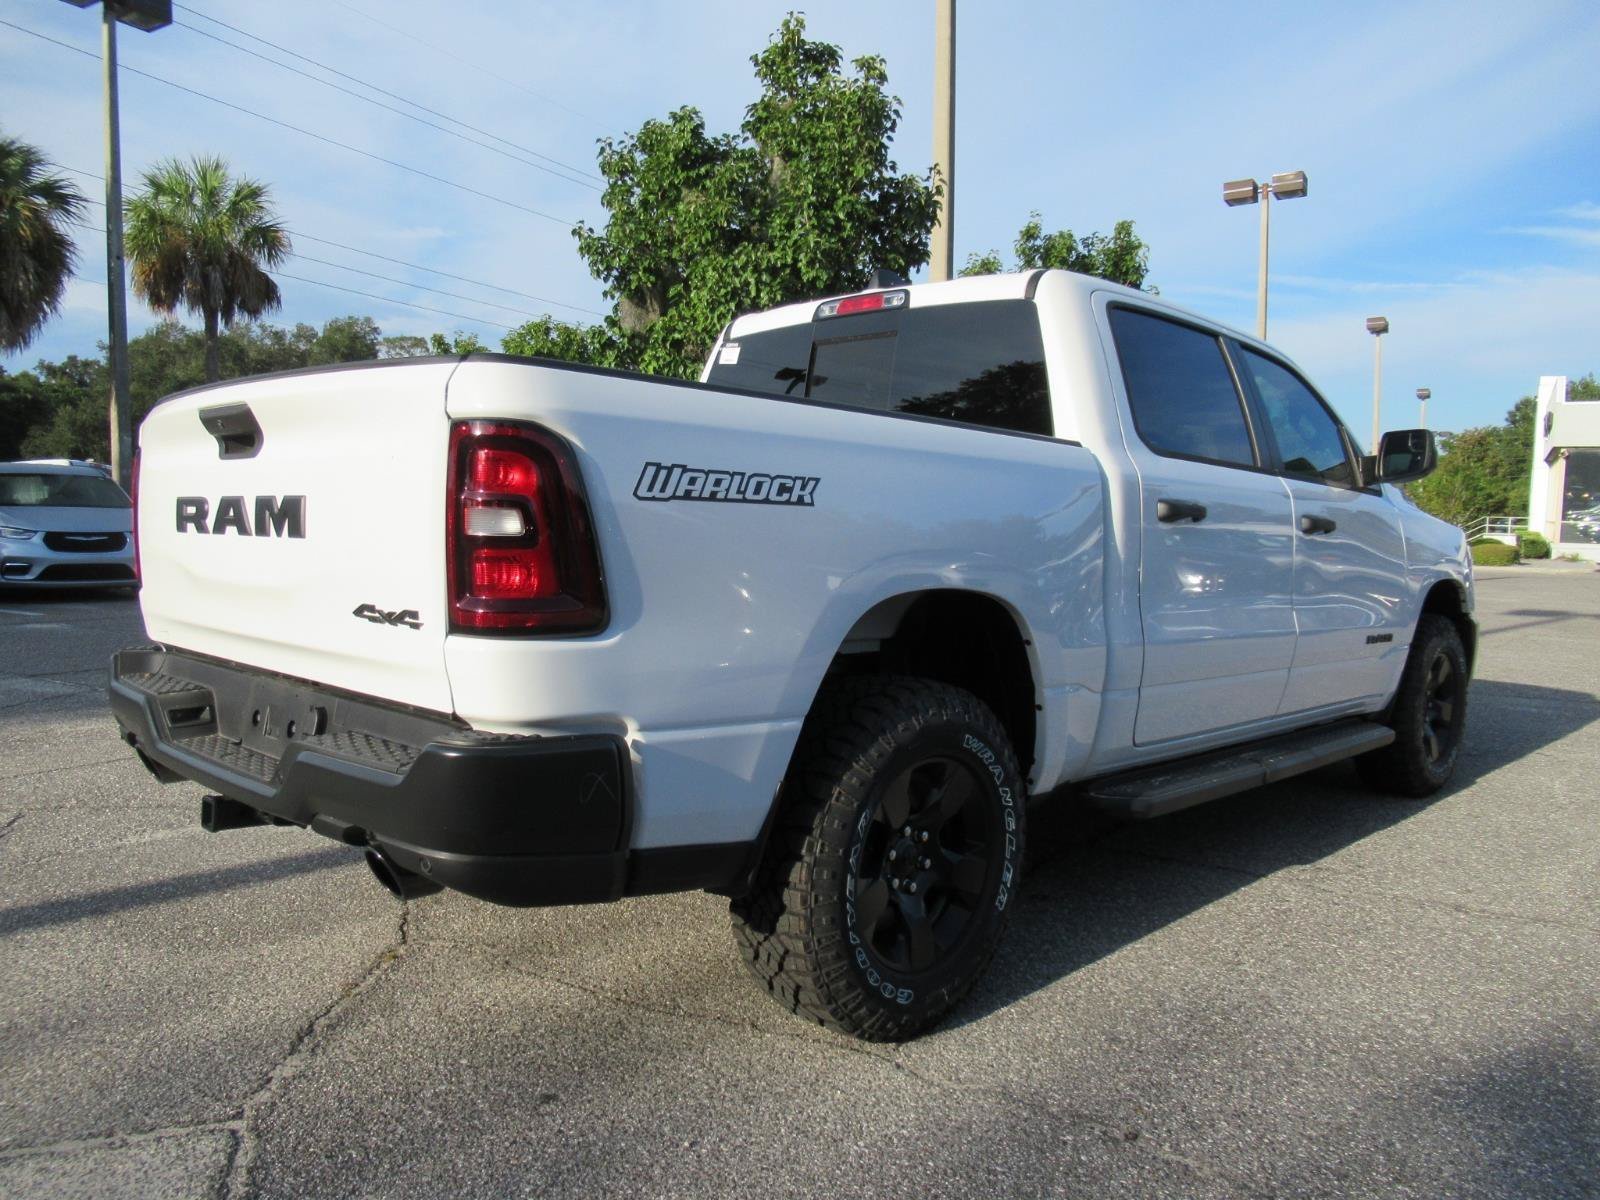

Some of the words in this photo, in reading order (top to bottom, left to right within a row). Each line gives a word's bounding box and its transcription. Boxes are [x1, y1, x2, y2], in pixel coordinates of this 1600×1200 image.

[633, 461, 821, 507] WARLOCK
[176, 495, 306, 539] RAM
[962, 734, 1016, 911] WRANGLER
